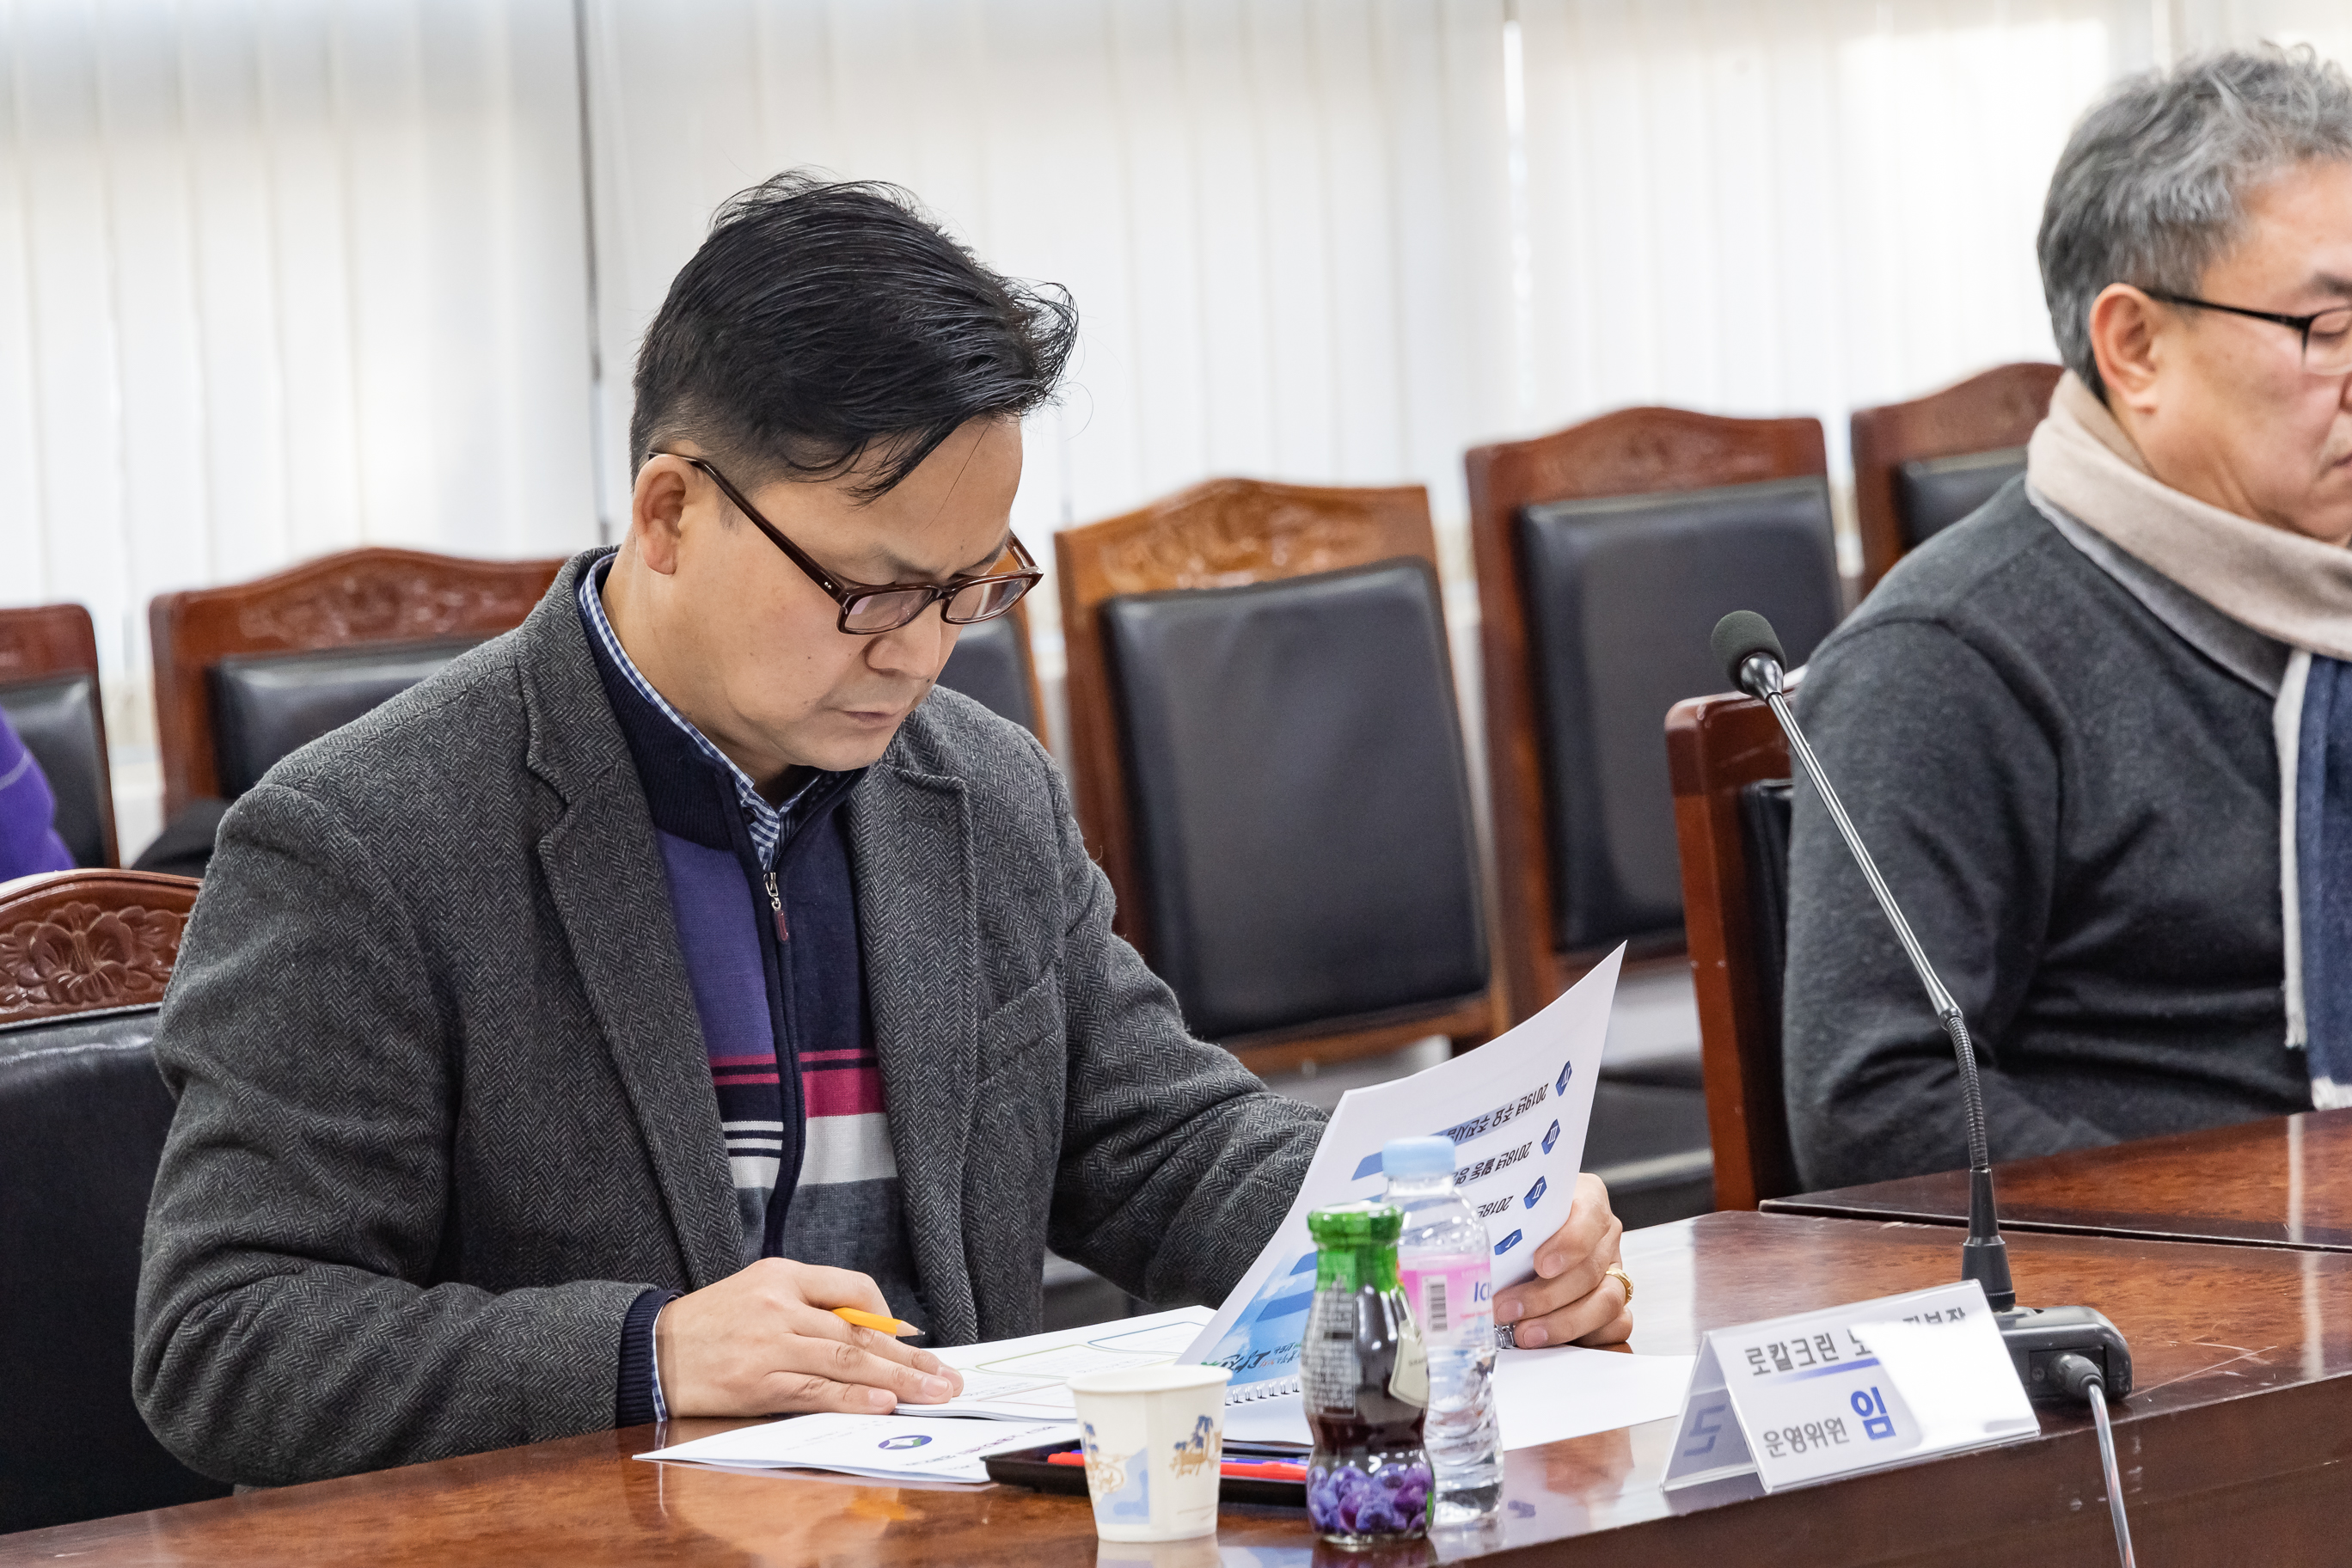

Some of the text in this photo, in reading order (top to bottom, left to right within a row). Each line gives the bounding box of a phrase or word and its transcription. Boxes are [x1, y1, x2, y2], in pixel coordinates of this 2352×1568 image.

[1491, 1103, 1515, 1128] 주요
[1515, 1082, 1549, 1117] 2019년
[1494, 1141, 1533, 1172] 2018년
[1744, 1332, 1840, 1376] 로칼크린
[1763, 1417, 1850, 1458] 운영위원
[1850, 1386, 1896, 1441] 임
